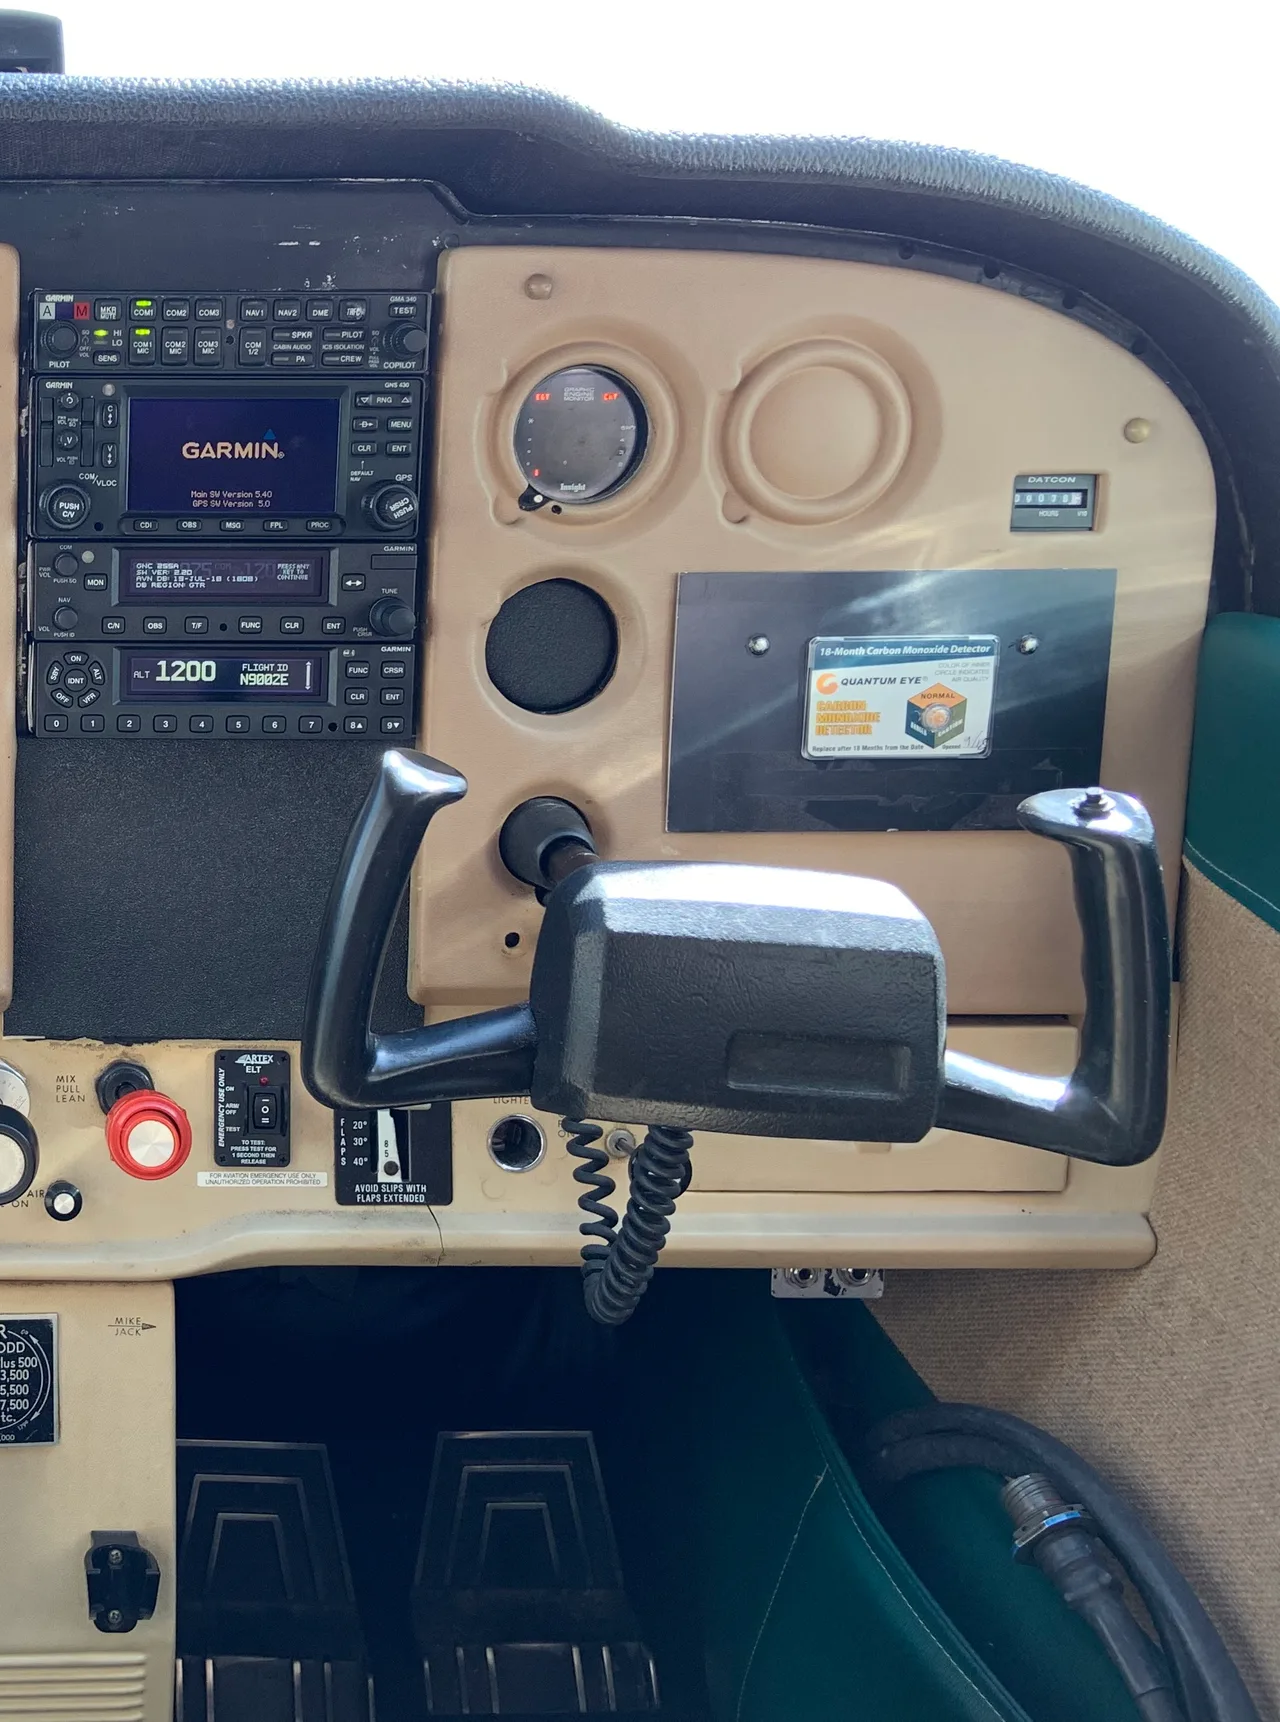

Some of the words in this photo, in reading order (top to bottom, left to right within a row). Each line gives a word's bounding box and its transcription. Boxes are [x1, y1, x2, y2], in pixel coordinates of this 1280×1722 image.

[246, 309, 264, 317] NAV1
[278, 309, 297, 317] NAV2
[312, 309, 329, 317] DME
[384, 361, 416, 369] COPILOT
[191, 490, 207, 498] Main
[210, 490, 220, 498] SW
[222, 490, 253, 498] Version
[255, 490, 273, 498] 5.40
[59, 502, 79, 510] PUSH
[192, 500, 208, 508] GPS
[210, 500, 220, 508] SW
[223, 500, 254, 508] Version
[820, 647, 866, 656] 18-Month
[867, 646, 901, 655] Carbon
[902, 646, 949, 655] Monoxide
[950, 645, 991, 654] Detector
[155, 660, 216, 681] 1200
[240, 673, 289, 686] N9002E
[841, 676, 896, 686] QUANTUM
[899, 676, 922, 684] EYE
[920, 692, 955, 700] NORMAL
[245, 1054, 274, 1063] ARTEX
[56, 1075, 76, 1083] MIX
[56, 1085, 80, 1093] PULL
[56, 1094, 85, 1103] LEAN
[353, 1121, 367, 1130] 20°
[353, 1137, 368, 1146] 30°
[353, 1157, 368, 1166] 40°
[354, 1184, 379, 1193] AVOID
[381, 1184, 404, 1193] SLIPS
[406, 1184, 427, 1193] WITH
[357, 1194, 381, 1203] FLAPS
[383, 1194, 425, 1203] EXTENDED
[115, 1317, 141, 1325] MIKE
[115, 1328, 141, 1336] JACK
[18, 1357, 38, 1368] 500
[0, 1370, 29, 1382] 3,500
[0, 1384, 29, 1397] 5,500
[0, 1399, 29, 1412] 7,500
